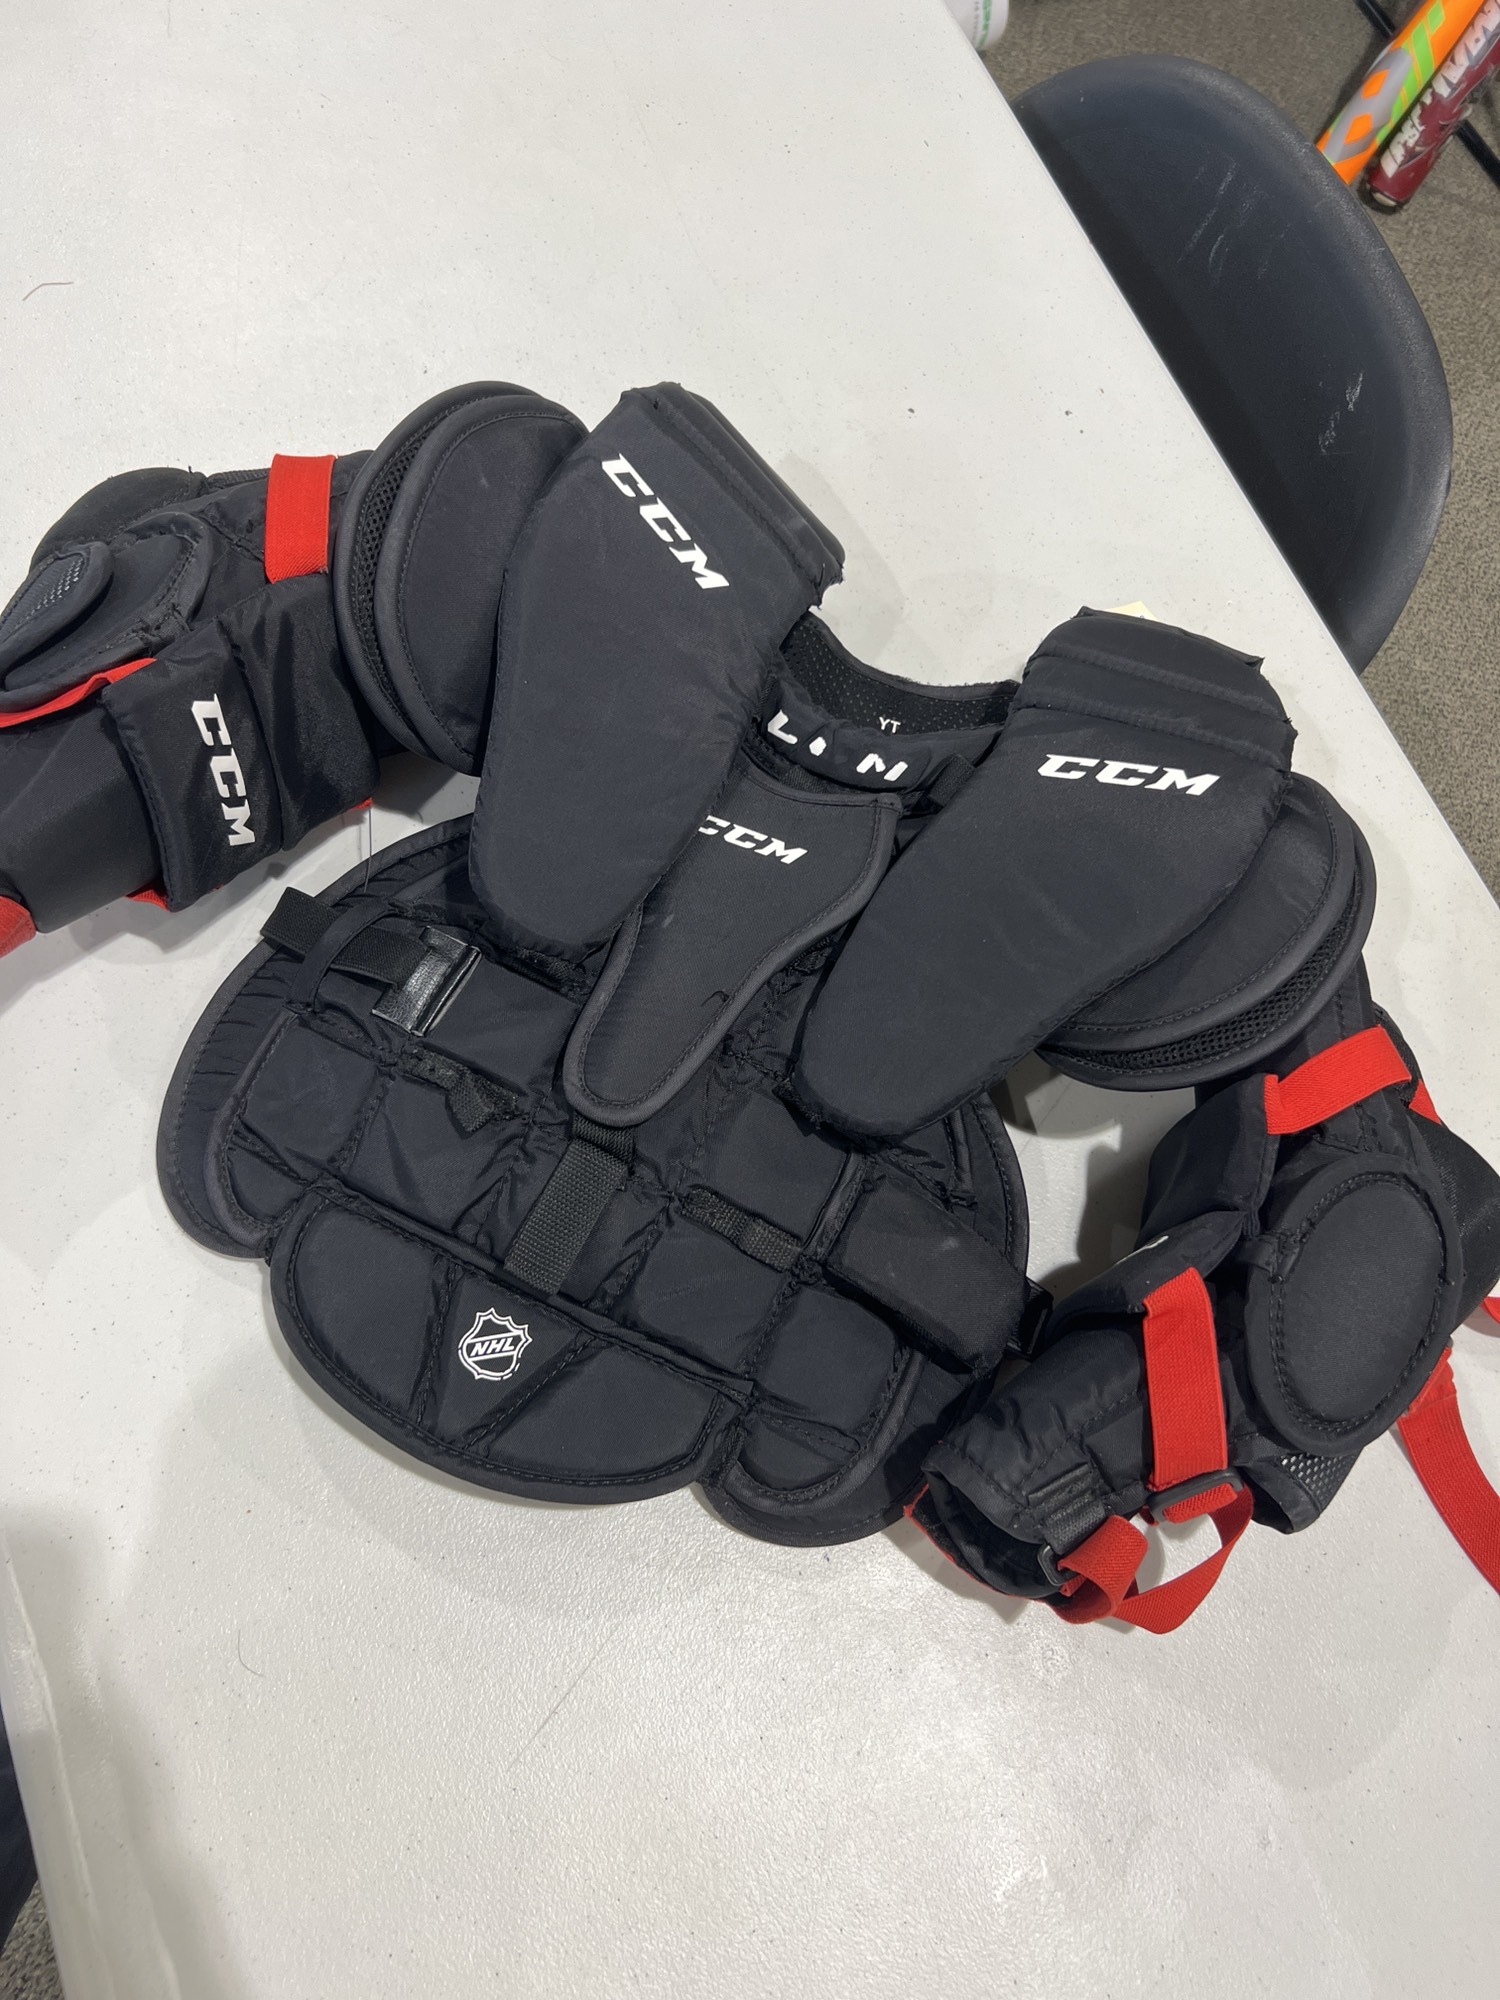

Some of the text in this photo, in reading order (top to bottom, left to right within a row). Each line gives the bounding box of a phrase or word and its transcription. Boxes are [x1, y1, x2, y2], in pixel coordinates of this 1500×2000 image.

[601, 453, 730, 589] CCM
[879, 716, 901, 734] YT
[191, 693, 256, 847] CCM
[1037, 754, 1221, 796] CCM
[469, 1337, 515, 1357] NHL
